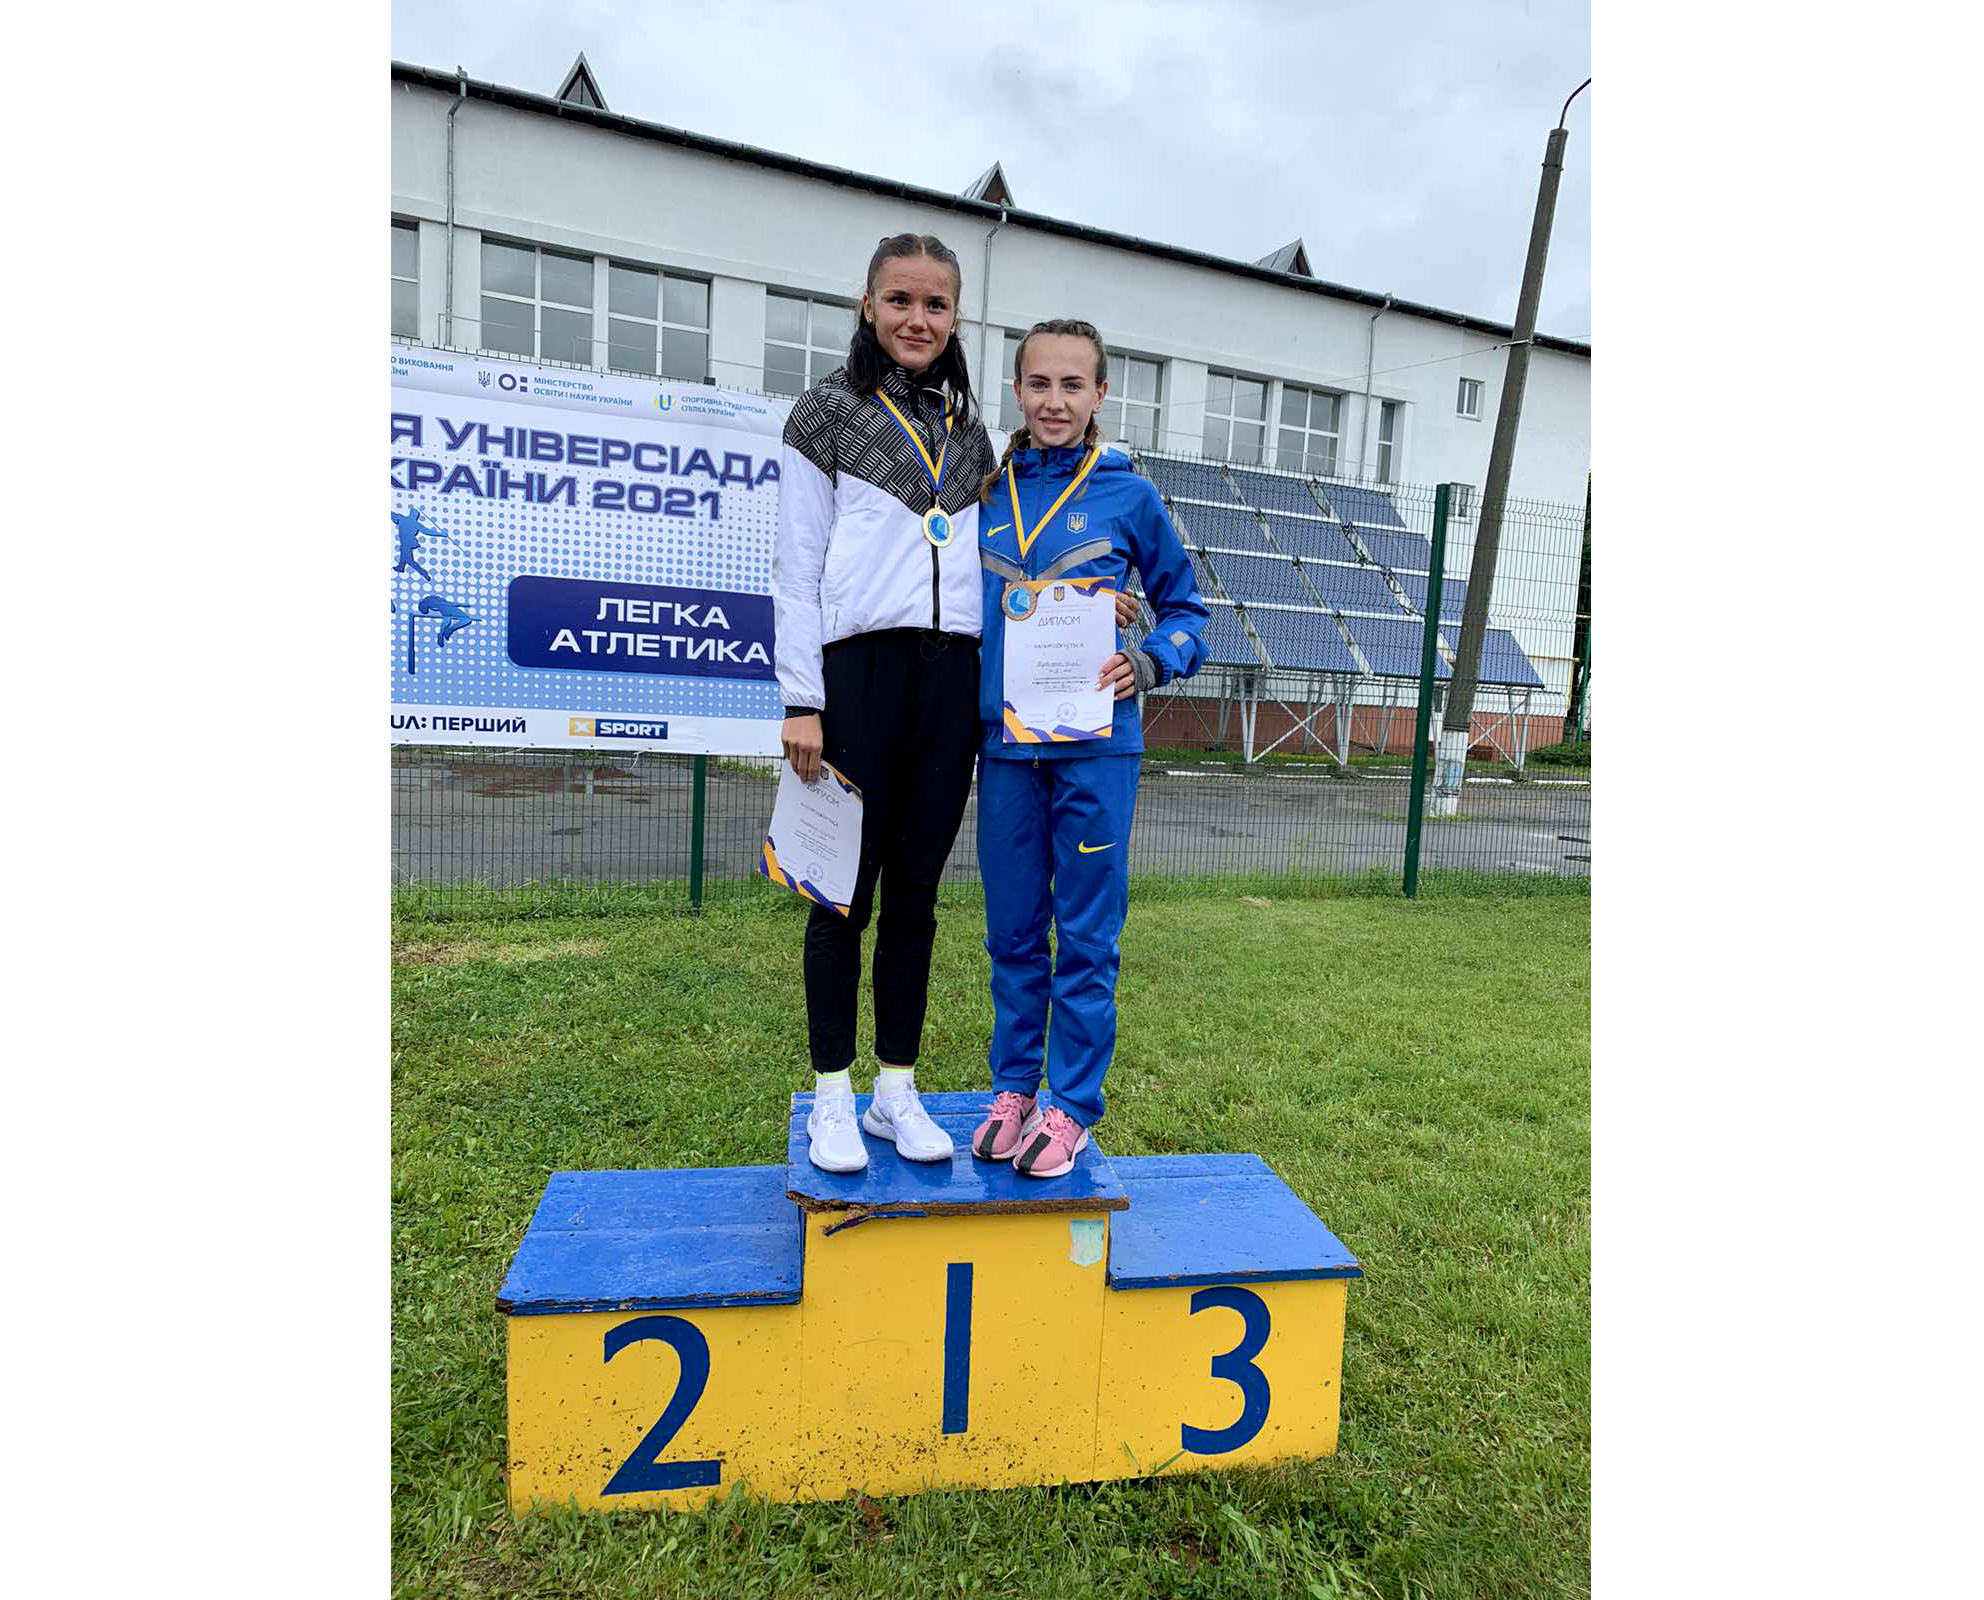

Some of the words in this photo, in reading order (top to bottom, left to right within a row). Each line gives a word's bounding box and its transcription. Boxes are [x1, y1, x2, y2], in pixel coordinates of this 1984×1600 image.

[391, 366, 409, 377] ЇНИ
[398, 357, 454, 372] ВИХОВАННЯ
[533, 376, 594, 391] МІНІСТЕРСТВО
[533, 387, 565, 399] ОСВІТИ
[569, 392, 597, 402] НАУКИ
[598, 394, 633, 406] УКРАЇНИ
[681, 396, 723, 406] СПОРТИВНА
[681, 405, 707, 414] СПІЛКА
[436, 417, 780, 491] УНІВЕРСІАДА
[592, 479, 721, 521] 2021
[596, 597, 731, 630] ЛЕГКА
[1038, 615, 1081, 627] ДИПЛОМ
[549, 628, 772, 665] АТЛЕТИКА
[432, 716, 526, 733] ПЕРШИЙ
[600, 722, 665, 736] SPORT
[942, 1262, 974, 1436] 1
[1181, 1286, 1272, 1456] 3
[601, 1315, 722, 1497] 2
